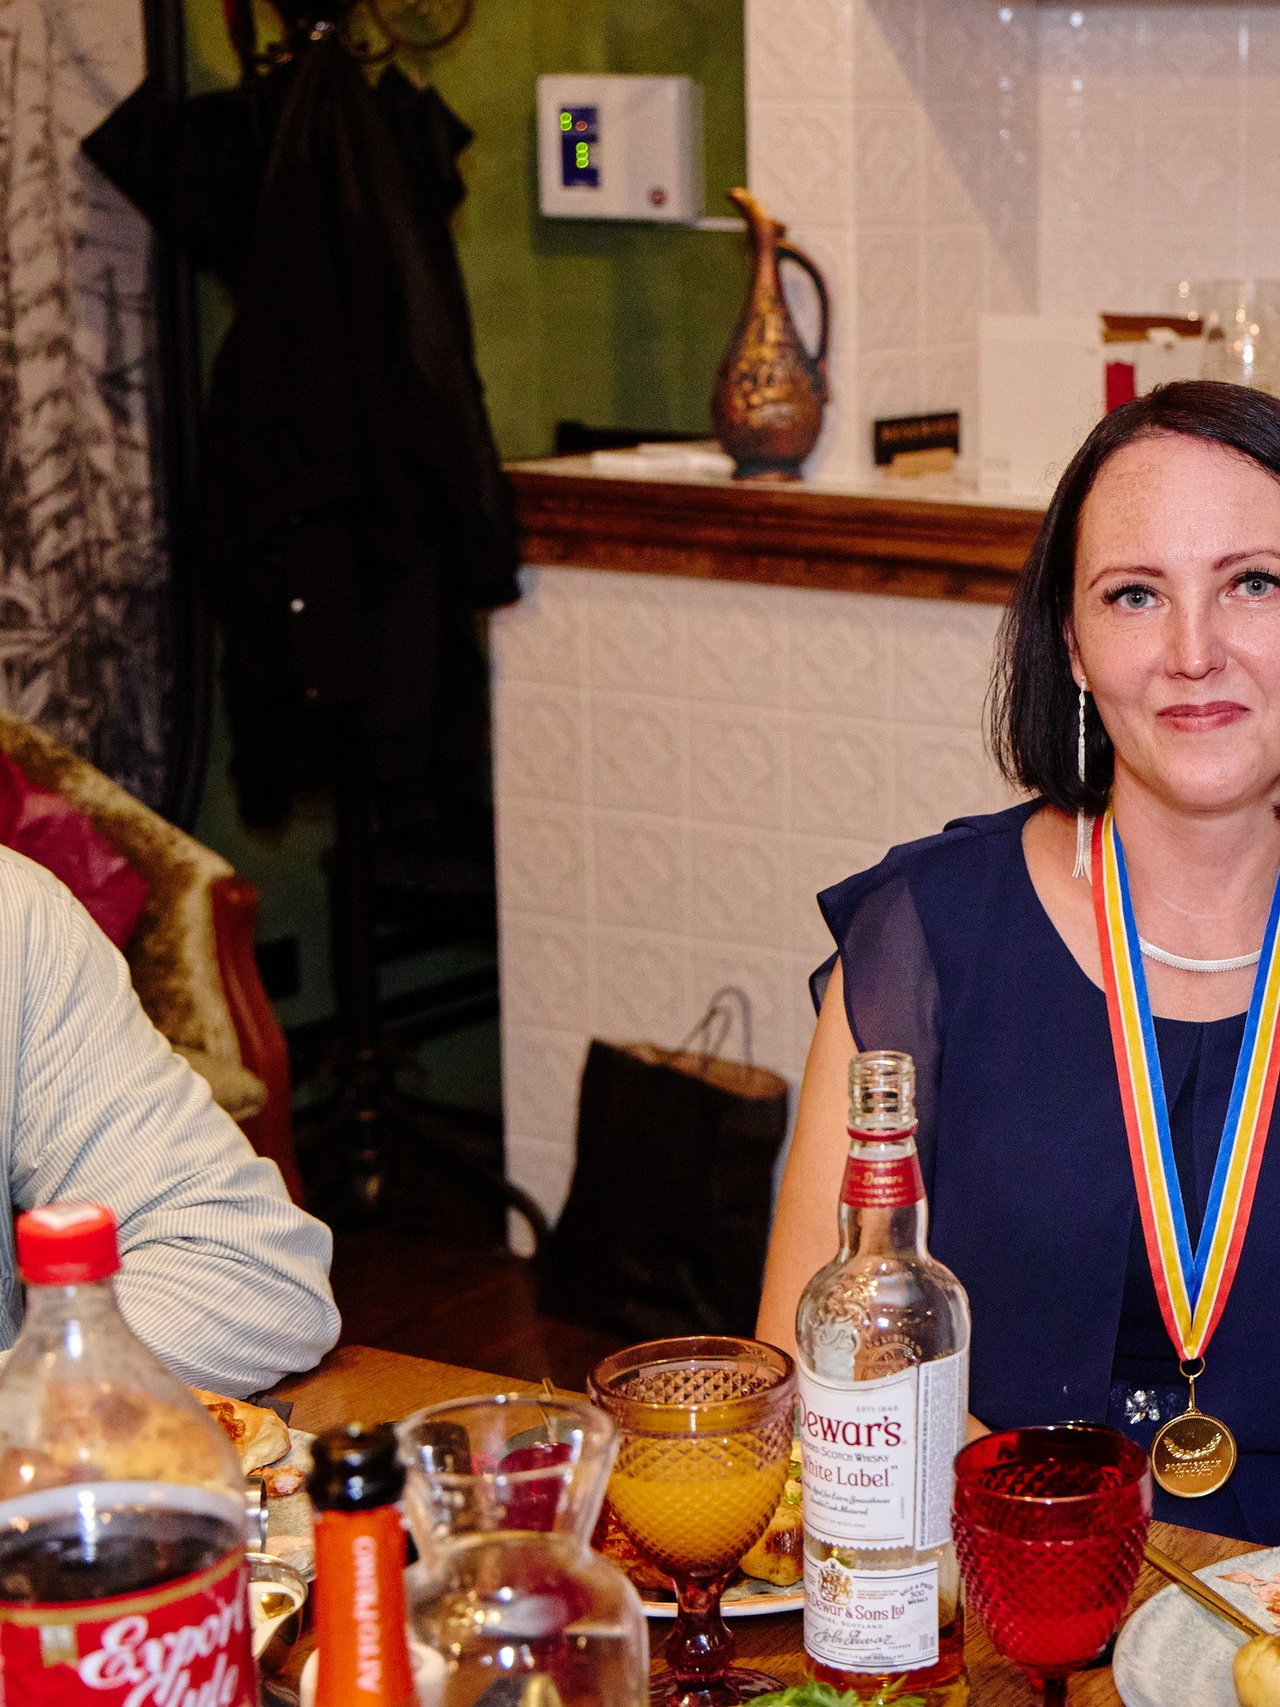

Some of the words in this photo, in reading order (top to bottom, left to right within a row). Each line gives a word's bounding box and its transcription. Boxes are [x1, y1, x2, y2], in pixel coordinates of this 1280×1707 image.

[854, 1453, 890, 1463] WHISKY
[844, 1607, 854, 1619] &
[855, 1604, 889, 1621] Sons
[891, 1604, 905, 1620] Ltd
